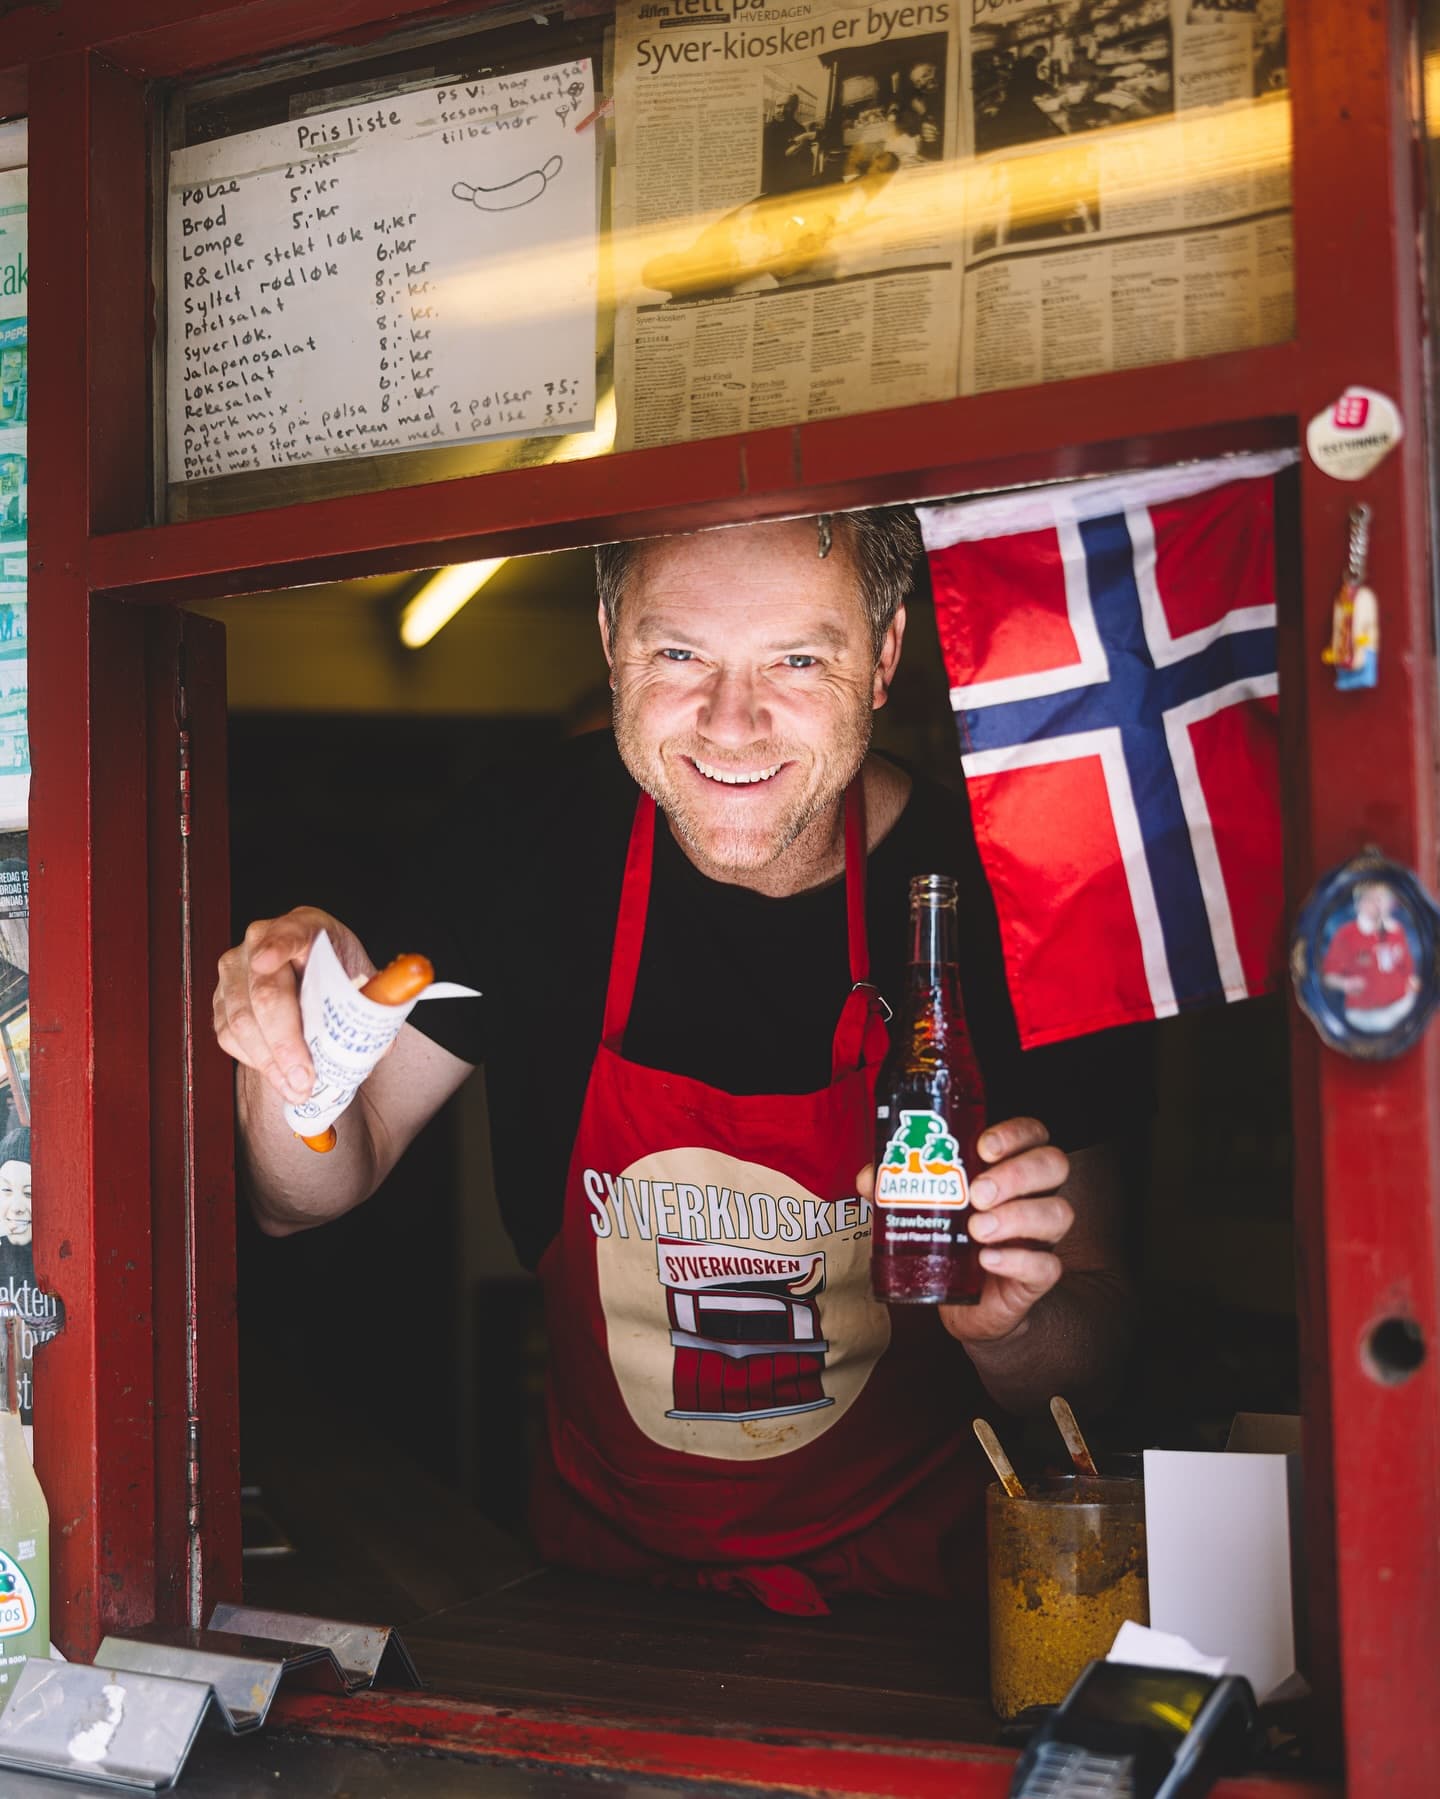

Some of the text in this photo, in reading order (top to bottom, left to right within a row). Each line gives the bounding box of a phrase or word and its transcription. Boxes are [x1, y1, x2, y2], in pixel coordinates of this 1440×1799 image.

[740, 5, 811, 22] HVERDAGEN
[636, 24, 825, 75] Syver-kiosken
[832, 17, 861, 40] er
[867, 3, 949, 40] byens
[466, 86, 485, 98] Vi
[442, 115, 538, 144] tilbehør
[182, 204, 227, 237] Brød
[182, 233, 244, 262] Lompe
[264, 237, 315, 267] stekt
[327, 227, 364, 248] løk
[0, 252, 29, 297] ak
[184, 285, 241, 317] Syltet
[4, 325, 28, 342] PEPS
[185, 297, 285, 340] Potetsalat
[184, 336, 316, 382] Jalapenosalat
[184, 365, 275, 402] Løksalat
[184, 387, 273, 419] Rekesalat
[269, 437, 298, 451] stor
[398, 404, 435, 425] med
[450, 401, 462, 415] 2
[469, 389, 532, 415] pølser
[880, 1177, 959, 1197] JARRITOS
[885, 1213, 952, 1232] Strawberry
[664, 1255, 801, 1284] SYVERKIOSKEN
